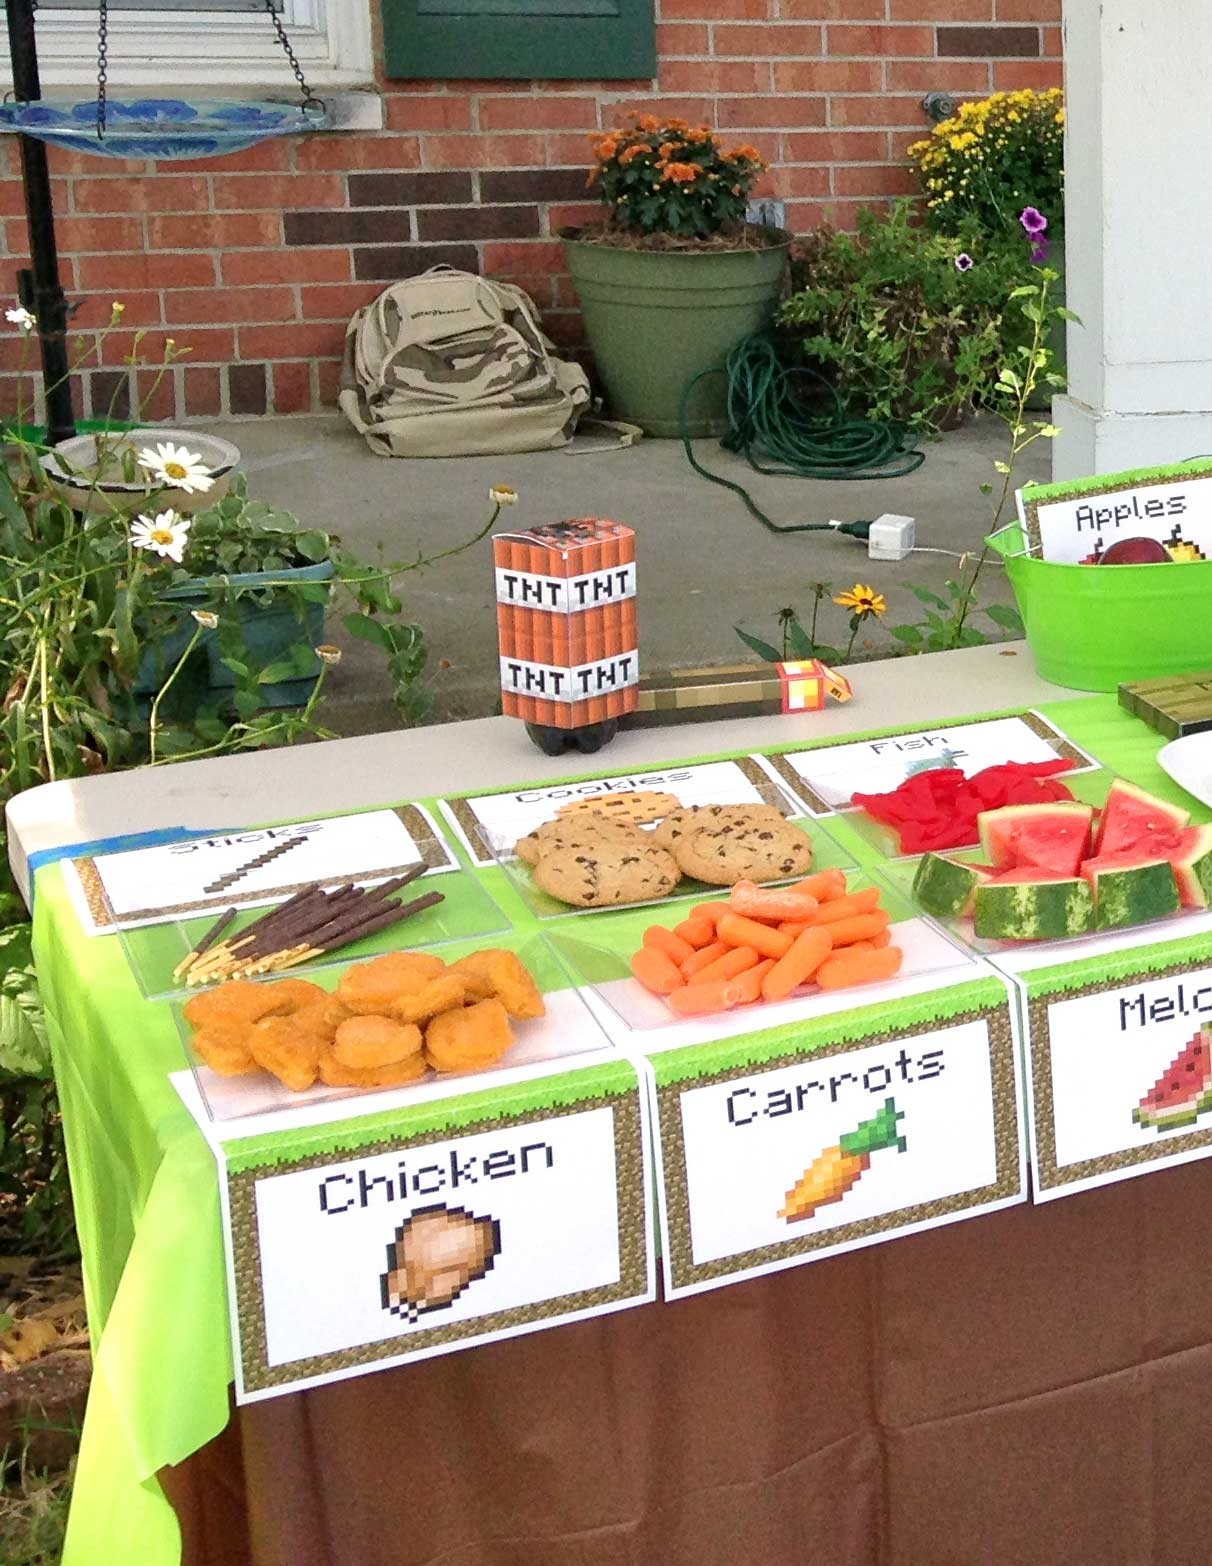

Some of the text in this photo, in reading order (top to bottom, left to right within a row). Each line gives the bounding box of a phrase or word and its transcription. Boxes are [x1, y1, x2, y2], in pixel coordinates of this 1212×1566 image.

[1076, 495, 1187, 532] Apples
[504, 569, 629, 606] TNT TNT
[508, 657, 632, 695] TNT TNT
[869, 735, 949, 755] Fish
[515, 771, 693, 803] Cookies
[168, 823, 324, 855] Sticks
[725, 1049, 946, 1126] Carrots
[318, 1139, 554, 1215] Chicken
